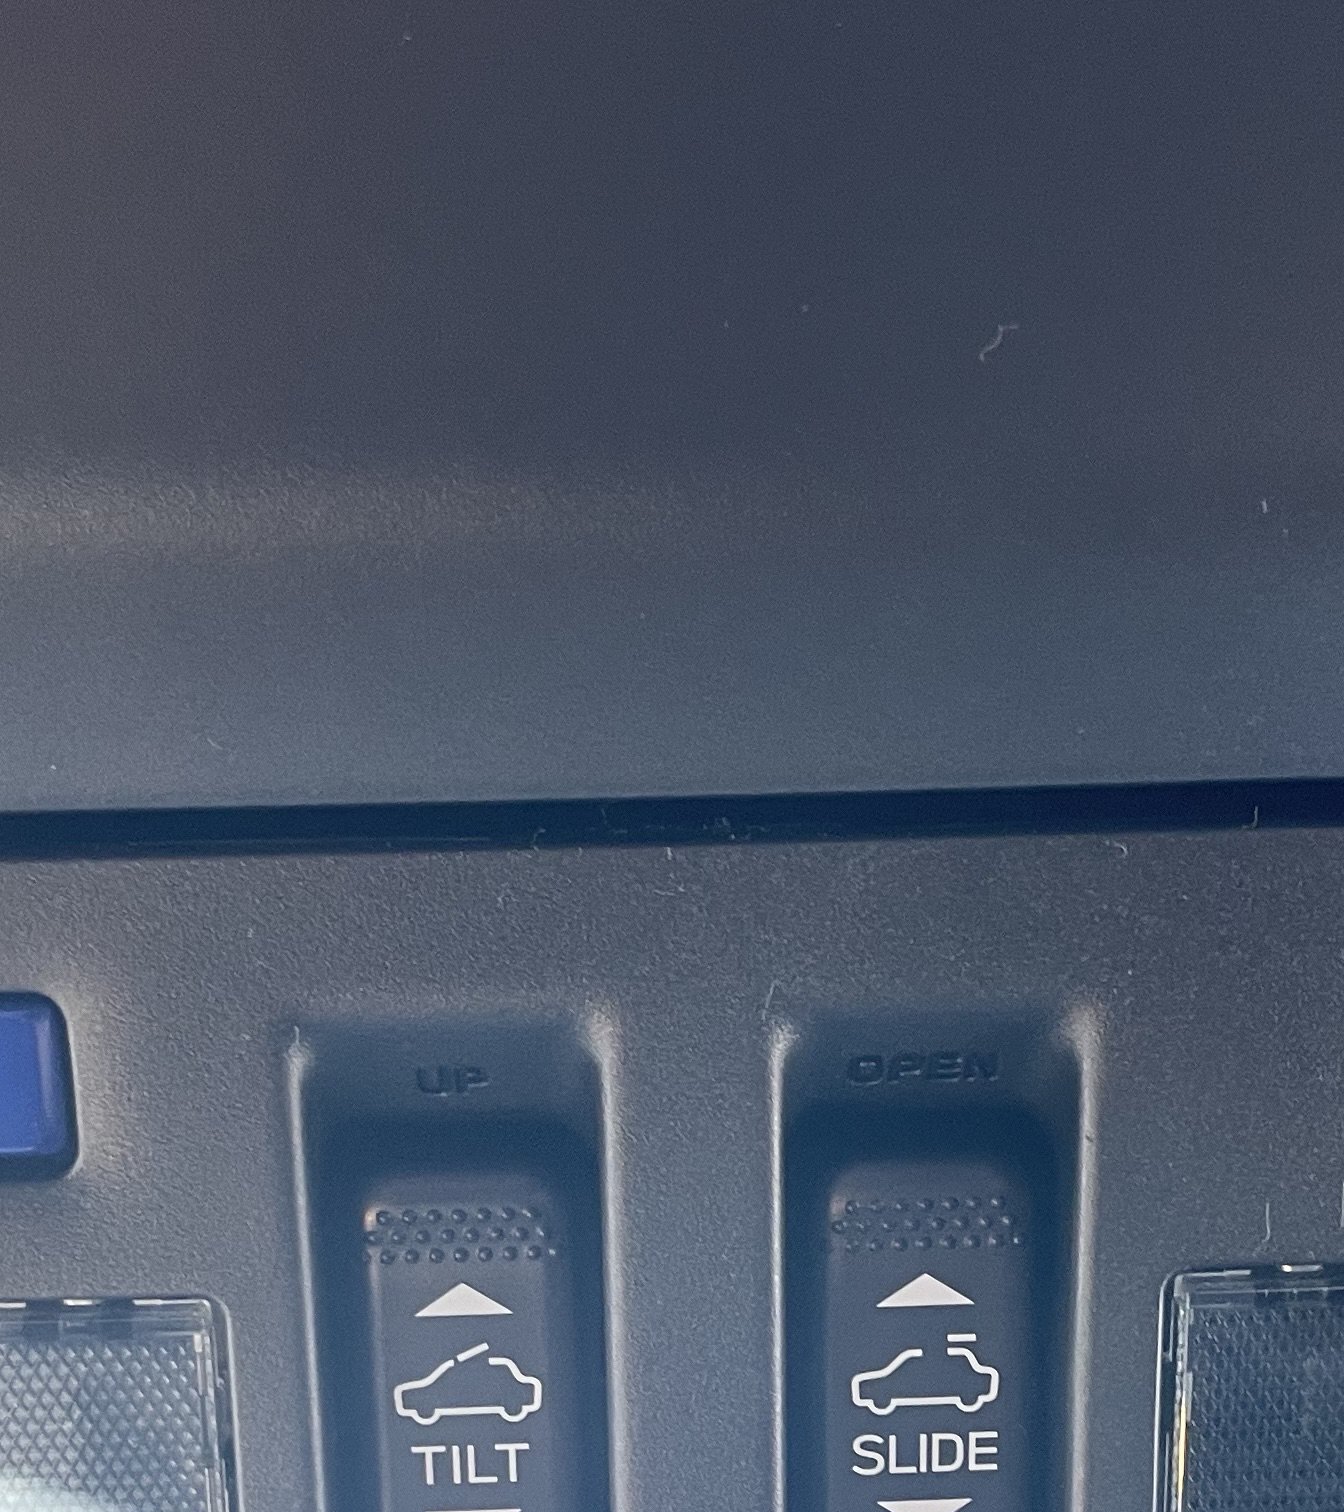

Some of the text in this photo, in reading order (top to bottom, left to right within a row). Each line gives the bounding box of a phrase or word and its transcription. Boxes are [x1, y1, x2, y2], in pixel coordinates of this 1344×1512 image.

[415, 1064, 490, 1097] UP
[847, 1053, 1000, 1086] OPEN
[410, 1442, 530, 1486] TILT
[851, 1430, 999, 1477] SLIDE
